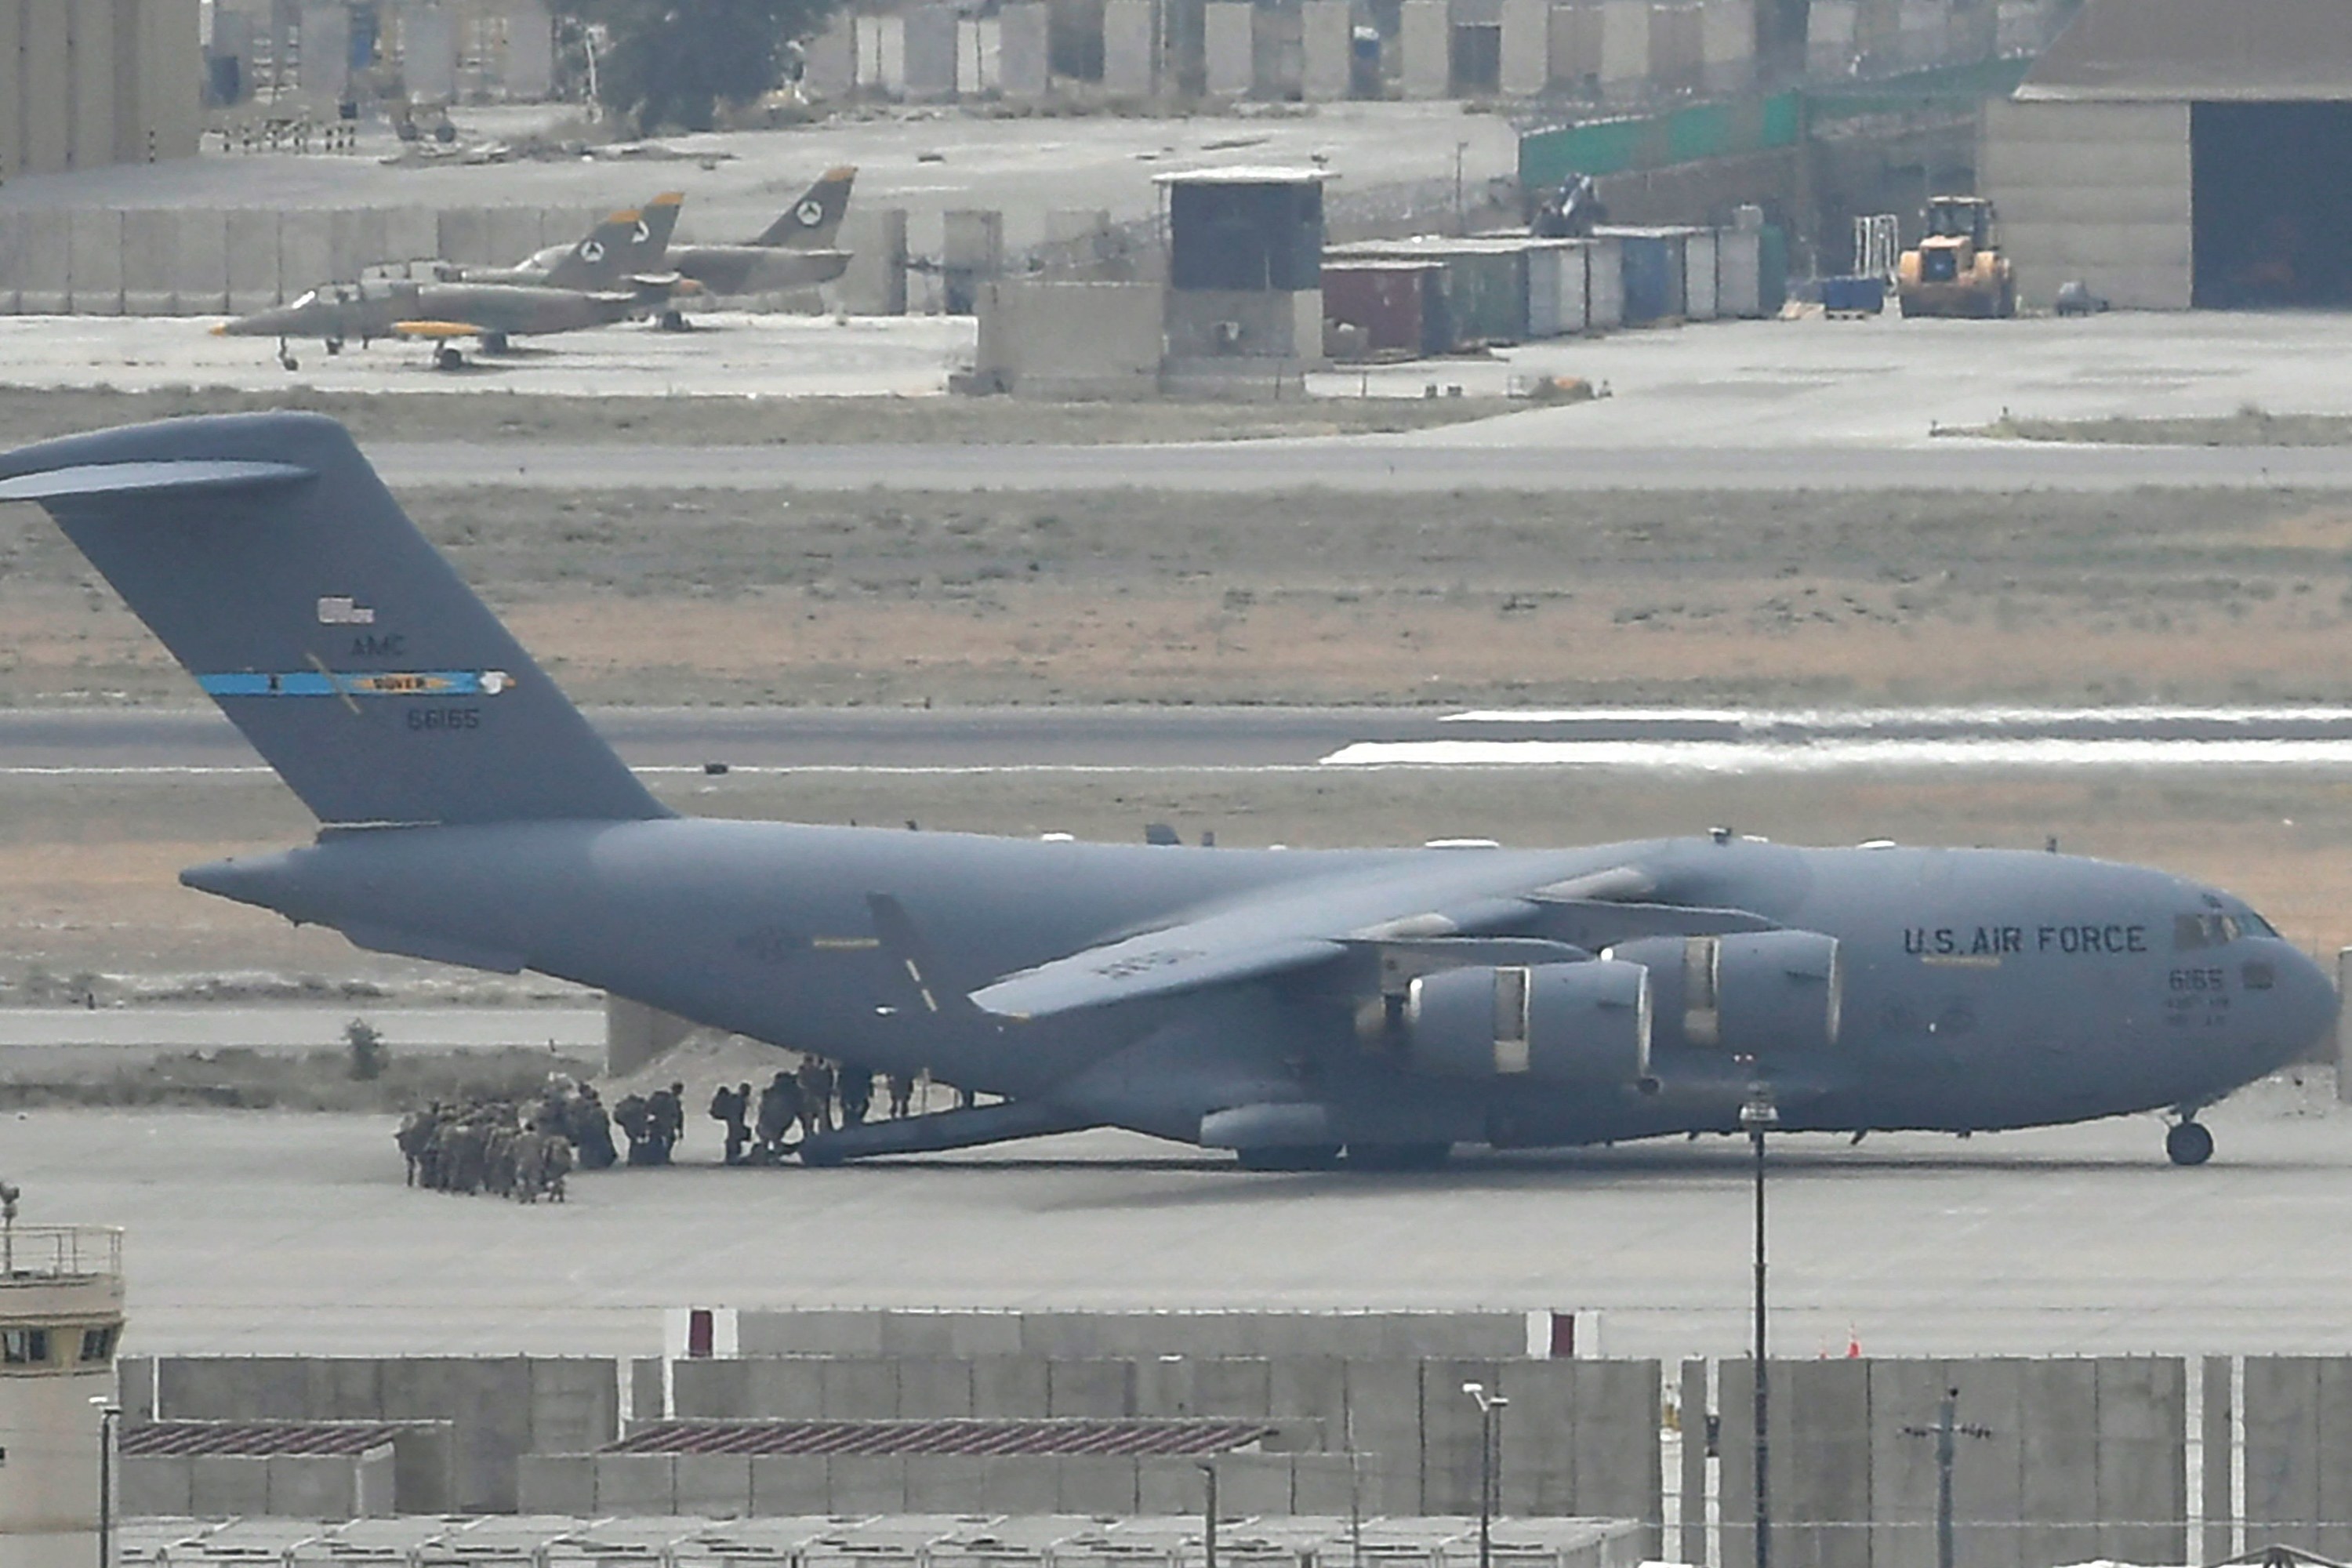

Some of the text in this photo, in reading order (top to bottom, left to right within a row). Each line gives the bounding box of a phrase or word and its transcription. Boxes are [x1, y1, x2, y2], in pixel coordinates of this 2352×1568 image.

[350, 635, 405, 656] AMC
[407, 709, 481, 730] 66165
[1904, 925, 2147, 955] U.S. AIR FORCE
[2169, 968, 2223, 991] 6165
